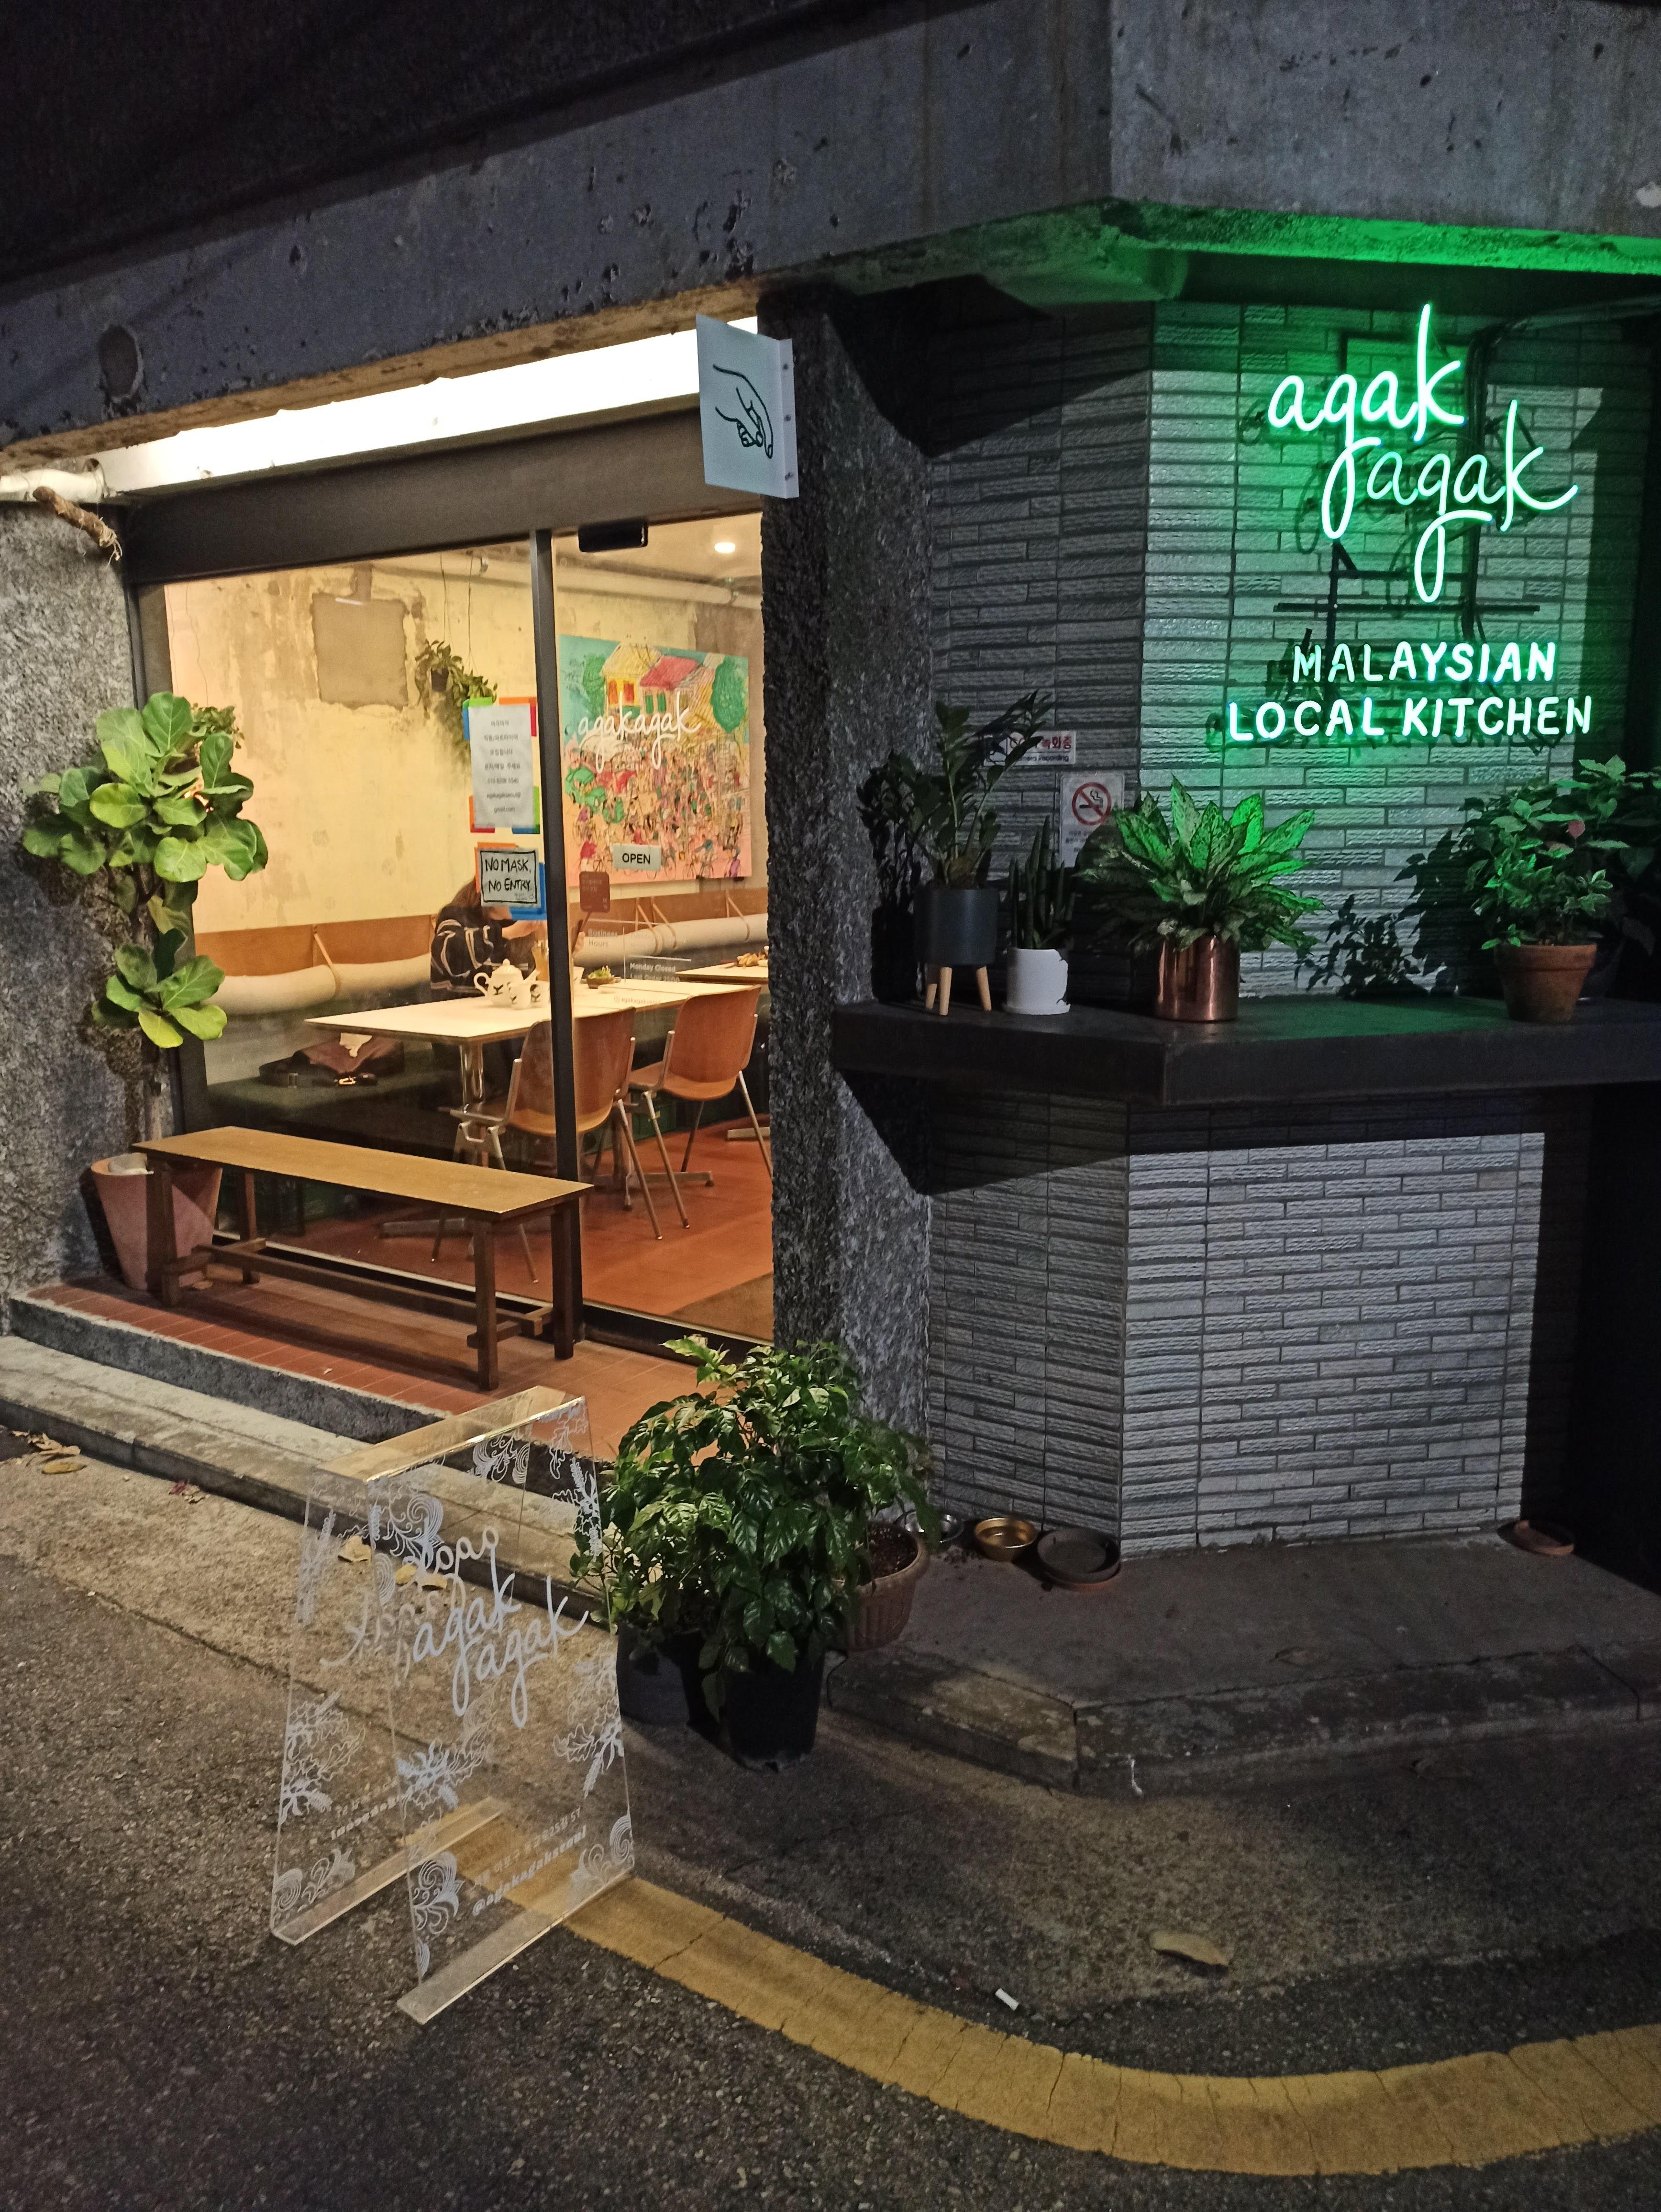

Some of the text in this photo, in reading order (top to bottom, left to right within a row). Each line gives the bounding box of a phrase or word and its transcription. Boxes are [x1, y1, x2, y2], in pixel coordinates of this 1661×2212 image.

[1267, 303, 1466, 539] agak
[1292, 641, 1556, 683] MALAYSIAN
[1228, 693, 1592, 741] LOCAL KITCHEN
[485, 857, 499, 872] NO
[622, 853, 651, 864] OPEN
[488, 880, 501, 893] NO
[588, 940, 609, 948] Hours
[630, 962, 676, 973] Monday Closed
[413, 1543, 522, 1717] agak
